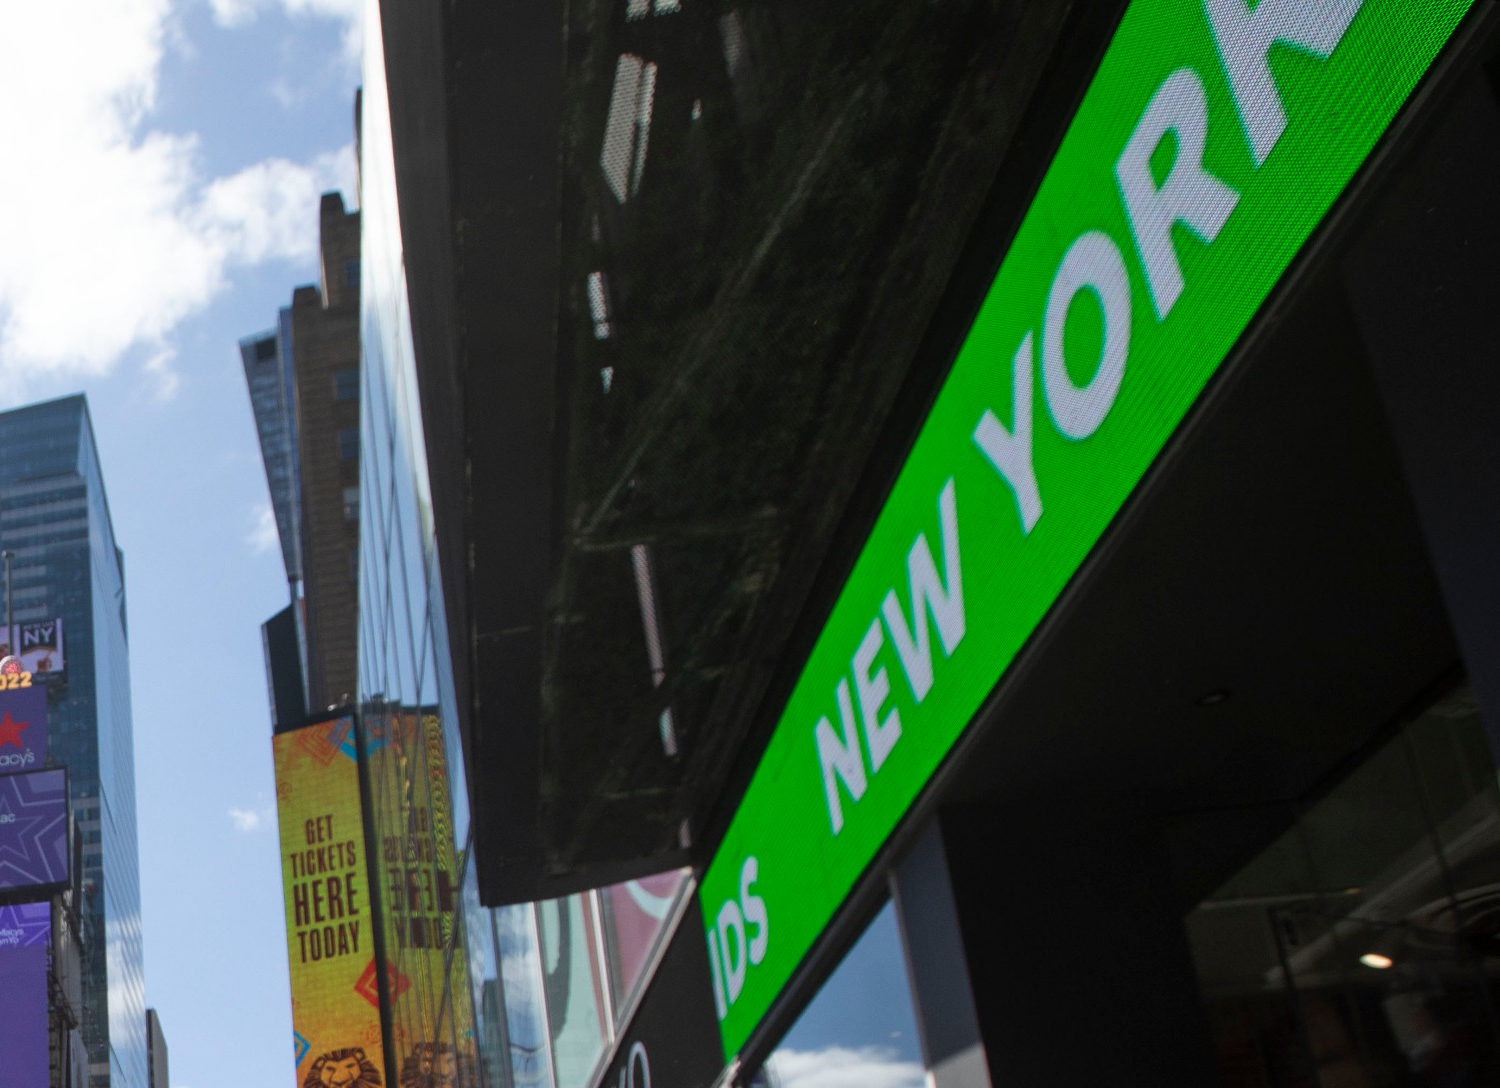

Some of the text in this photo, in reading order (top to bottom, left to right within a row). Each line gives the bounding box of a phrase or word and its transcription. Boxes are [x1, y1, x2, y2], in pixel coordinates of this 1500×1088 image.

[24, 626, 53, 646] NY
[813, 475, 967, 838] NEW
[305, 814, 333, 845] GET
[290, 839, 357, 879] TICKETS
[293, 871, 359, 927] HERE
[298, 919, 359, 963] TODAY
